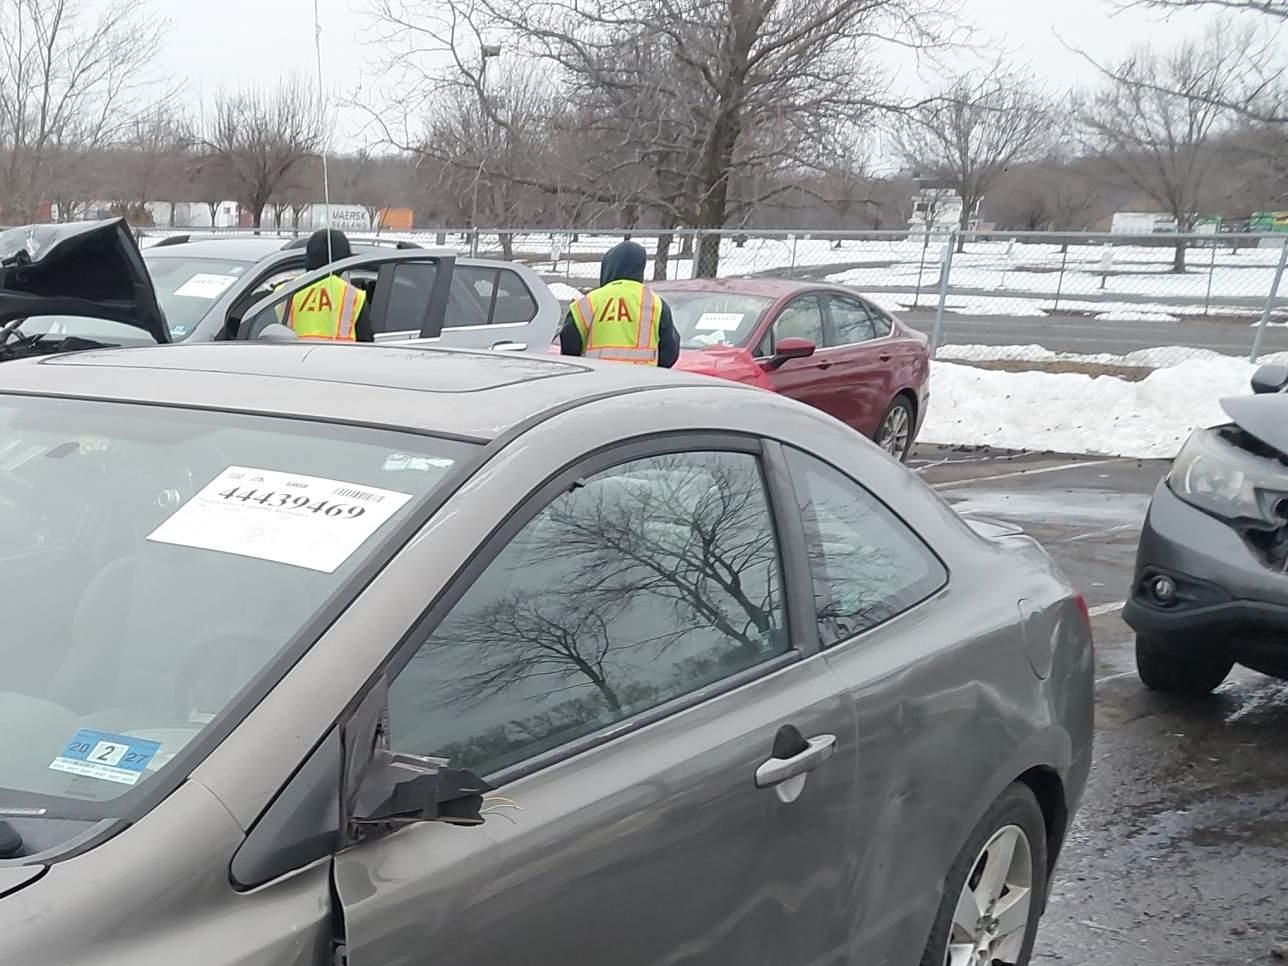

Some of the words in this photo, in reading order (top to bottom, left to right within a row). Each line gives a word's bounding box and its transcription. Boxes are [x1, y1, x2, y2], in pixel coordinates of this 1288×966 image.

[332, 210, 367, 220] MAERSK
[218, 486, 367, 519] 44439469
[70, 741, 90, 753] 20
[97, 745, 115, 761] 2
[124, 752, 149, 763] 27
